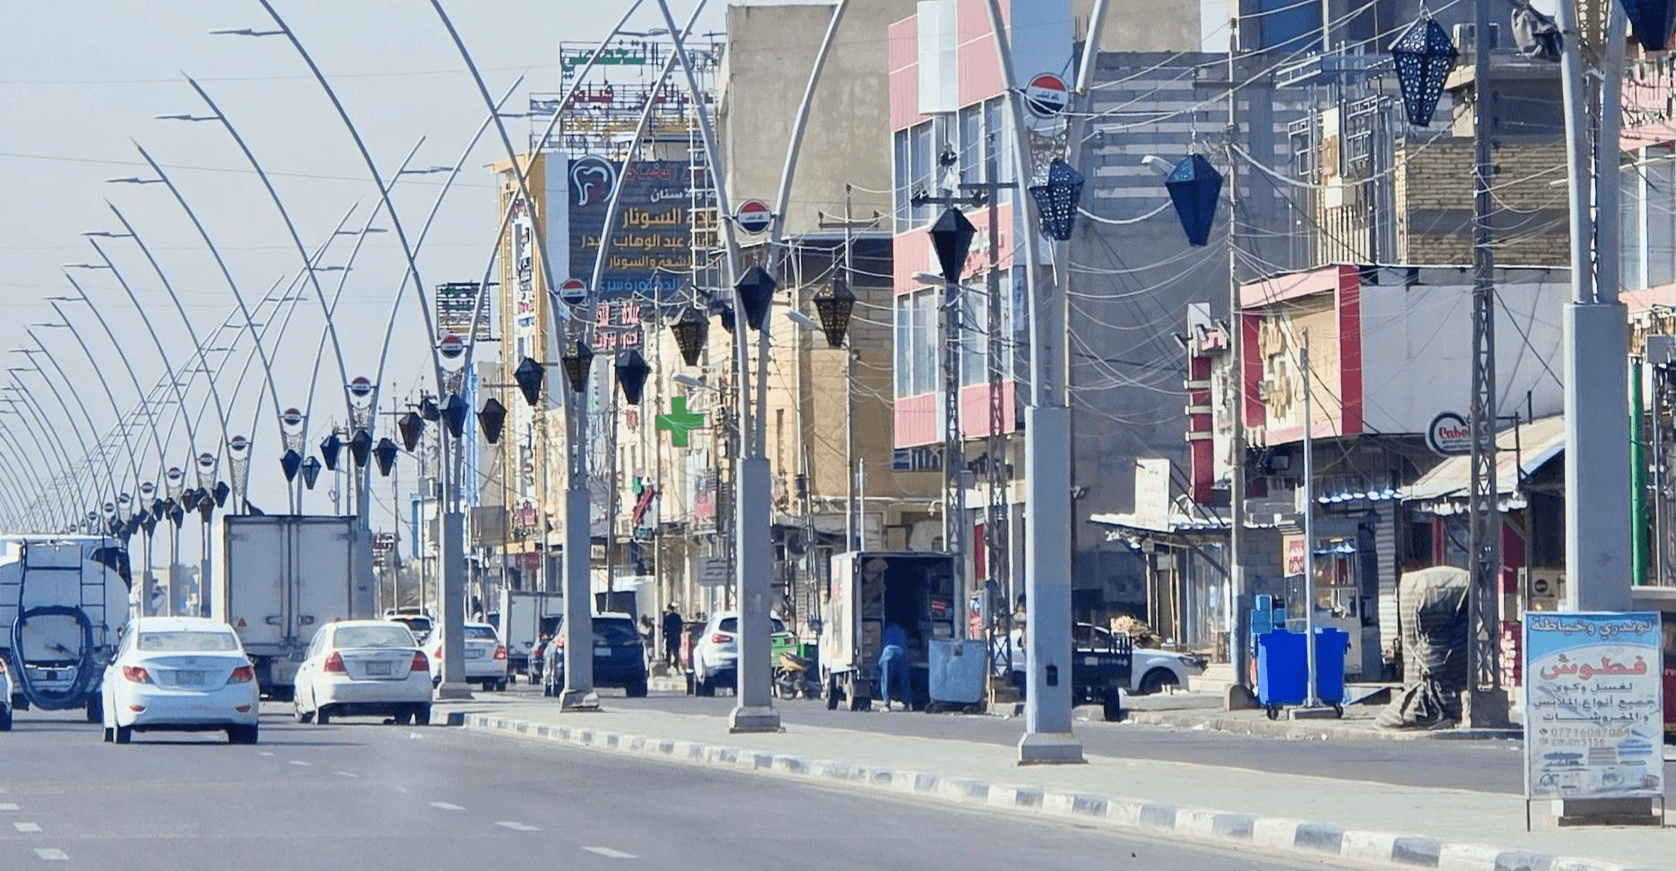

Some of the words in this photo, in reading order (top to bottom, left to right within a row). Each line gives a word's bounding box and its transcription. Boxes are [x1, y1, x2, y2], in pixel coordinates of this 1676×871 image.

[622, 207, 682, 229] السونار
[1531, 616, 1595, 636] وخياطة
[1533, 698, 1577, 710] الملابس
[1618, 698, 1655, 710] جميع
